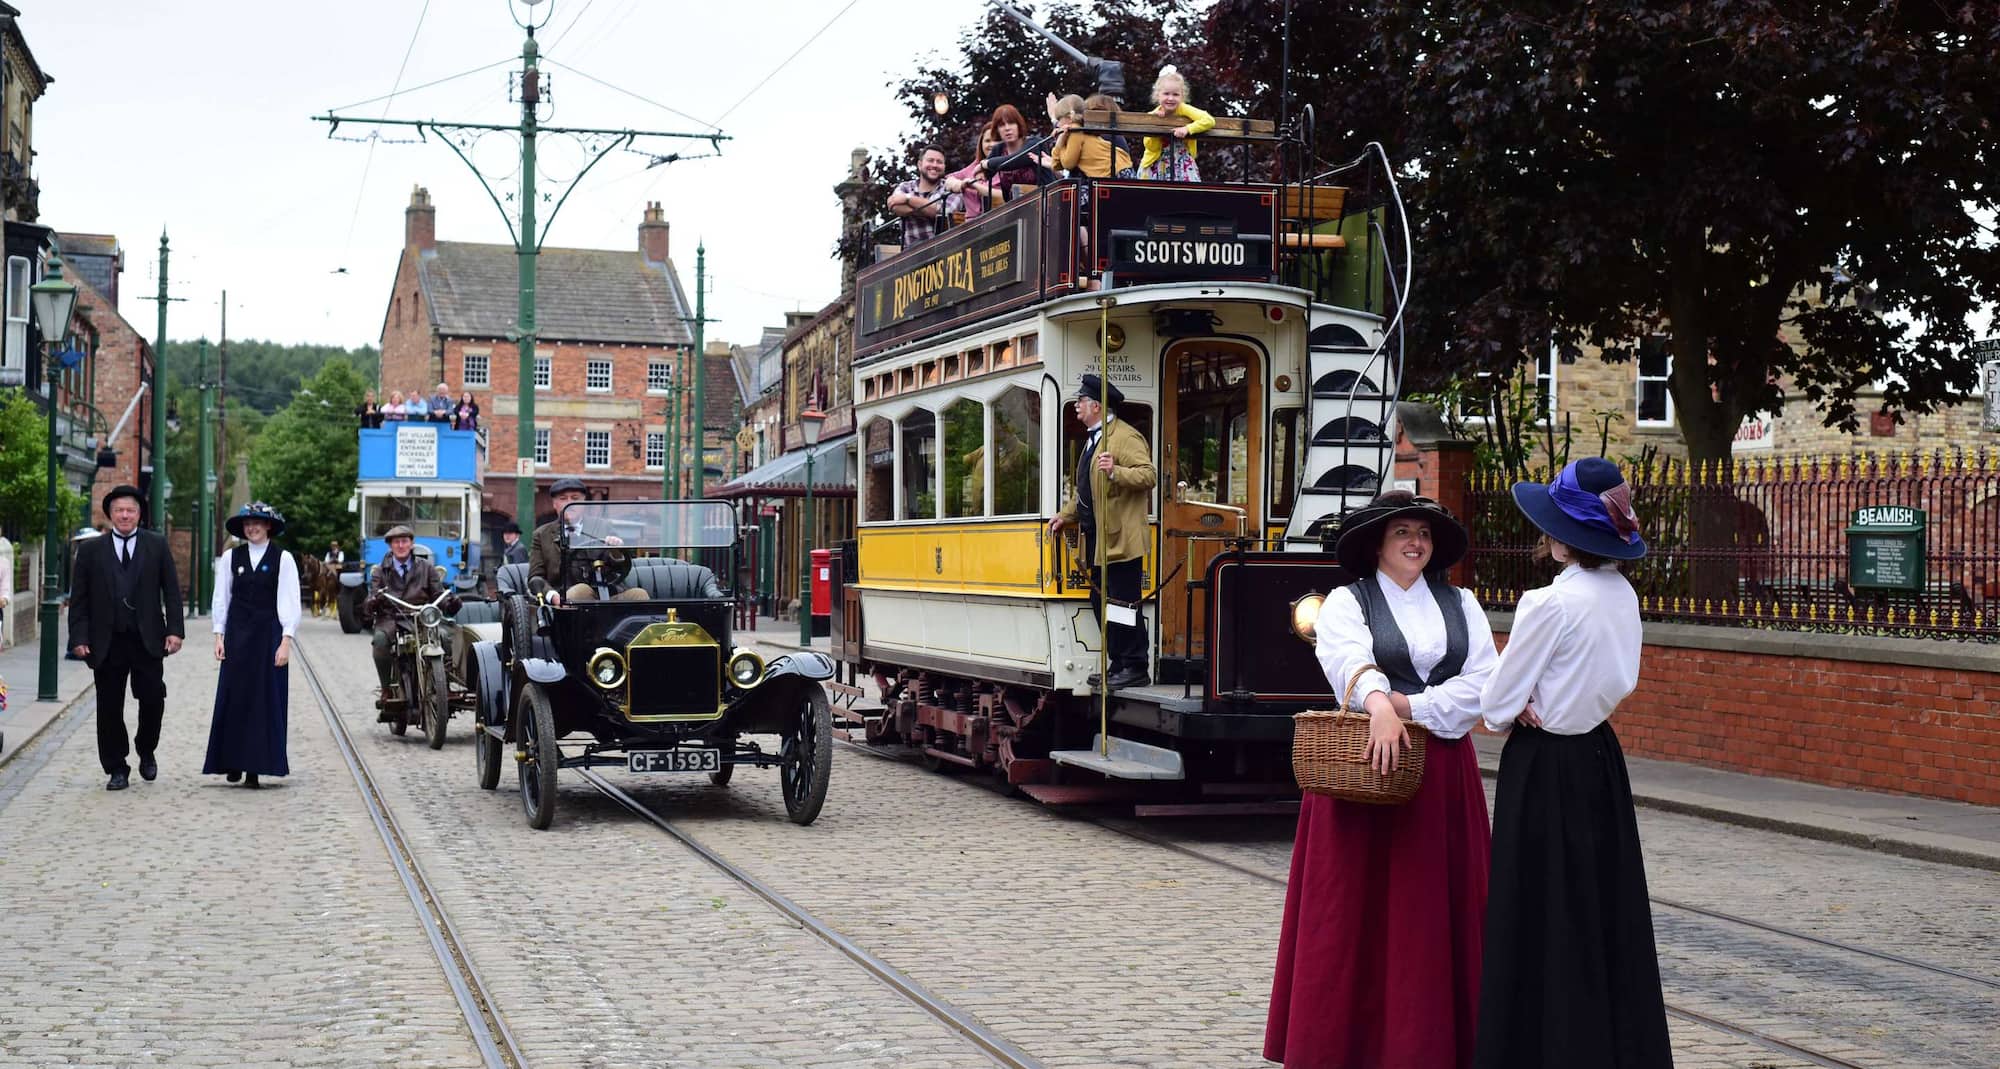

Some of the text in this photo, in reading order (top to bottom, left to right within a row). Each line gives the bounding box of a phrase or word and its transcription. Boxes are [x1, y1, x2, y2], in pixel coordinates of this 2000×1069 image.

[1134, 240, 1245, 265] SCOTSWOOD
[892, 247, 975, 320] RINGTONS TEA
[1107, 355, 1129, 363] SEAT
[1097, 364, 1136, 372] USTAIRS
[522, 459, 530, 474] F
[1859, 507, 1914, 525] BEAMISH
[660, 627, 688, 641] Ford
